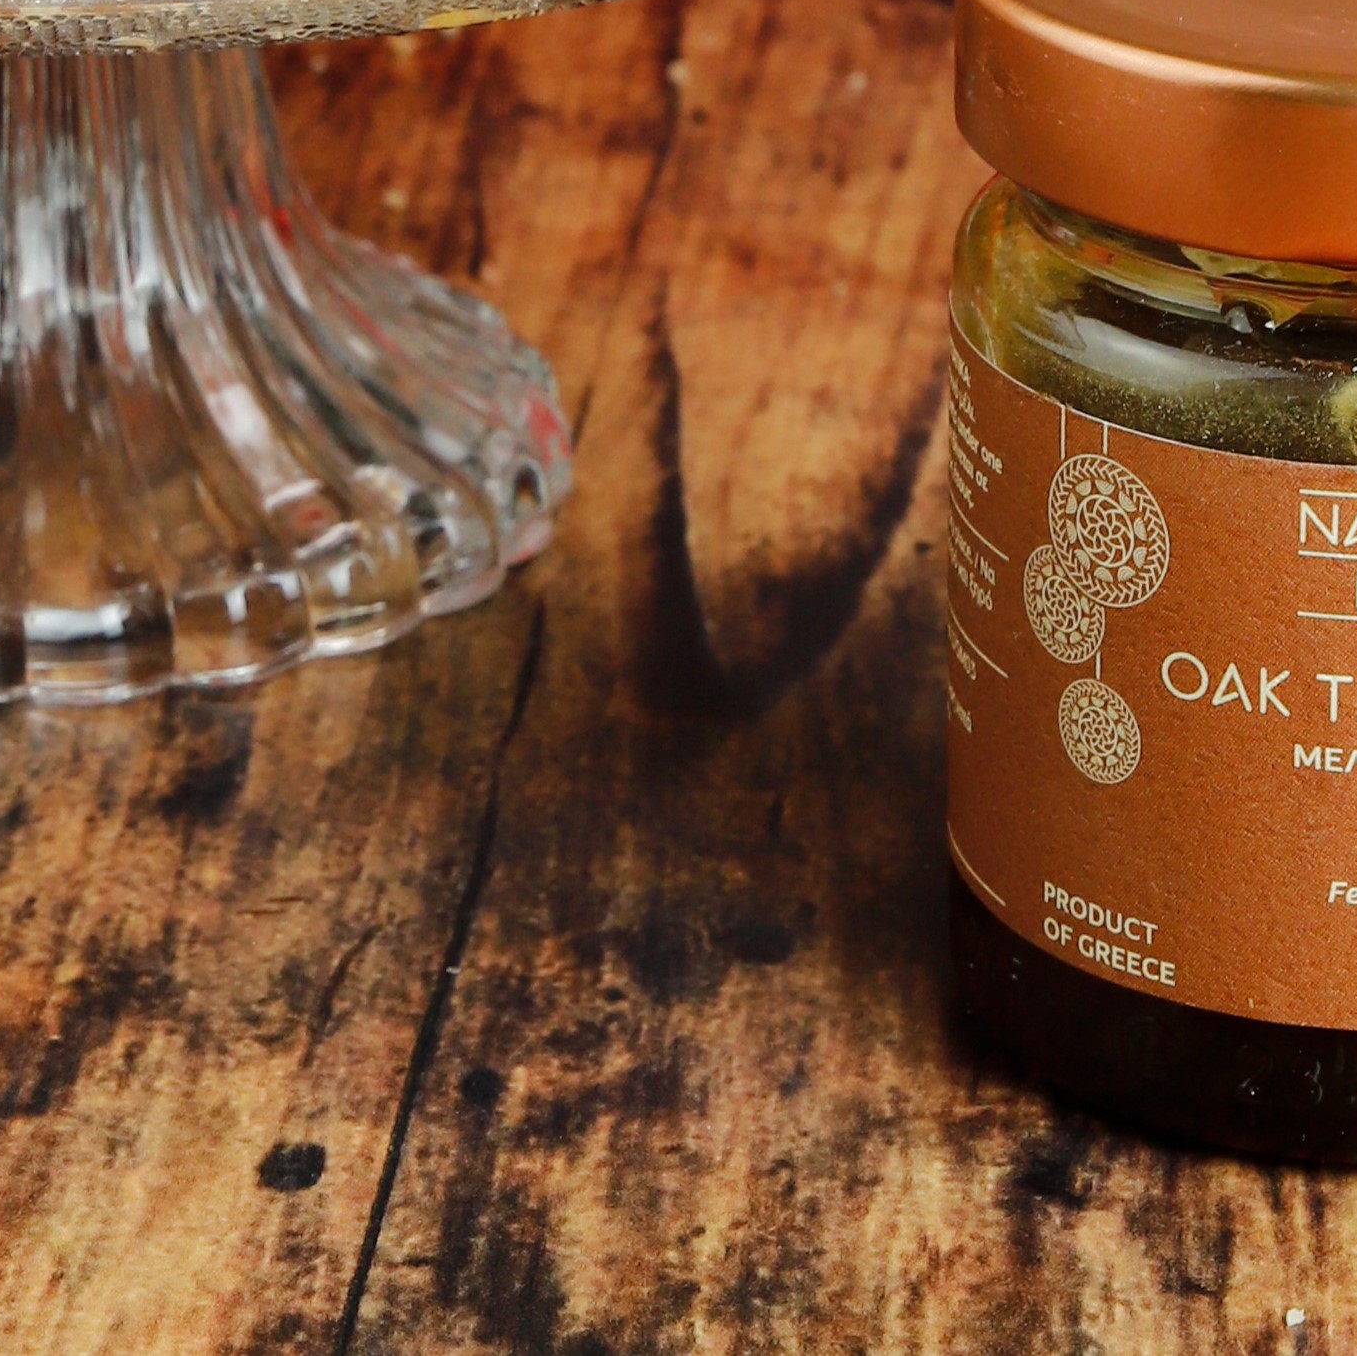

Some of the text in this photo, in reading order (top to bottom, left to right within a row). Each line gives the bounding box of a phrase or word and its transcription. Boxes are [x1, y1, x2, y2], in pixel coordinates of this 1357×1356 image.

[981, 445, 1003, 475] one
[1161, 652, 1290, 717] OAK
[1044, 880, 1158, 945] PRODUCT
[1044, 917, 1176, 986] OF GREECE
